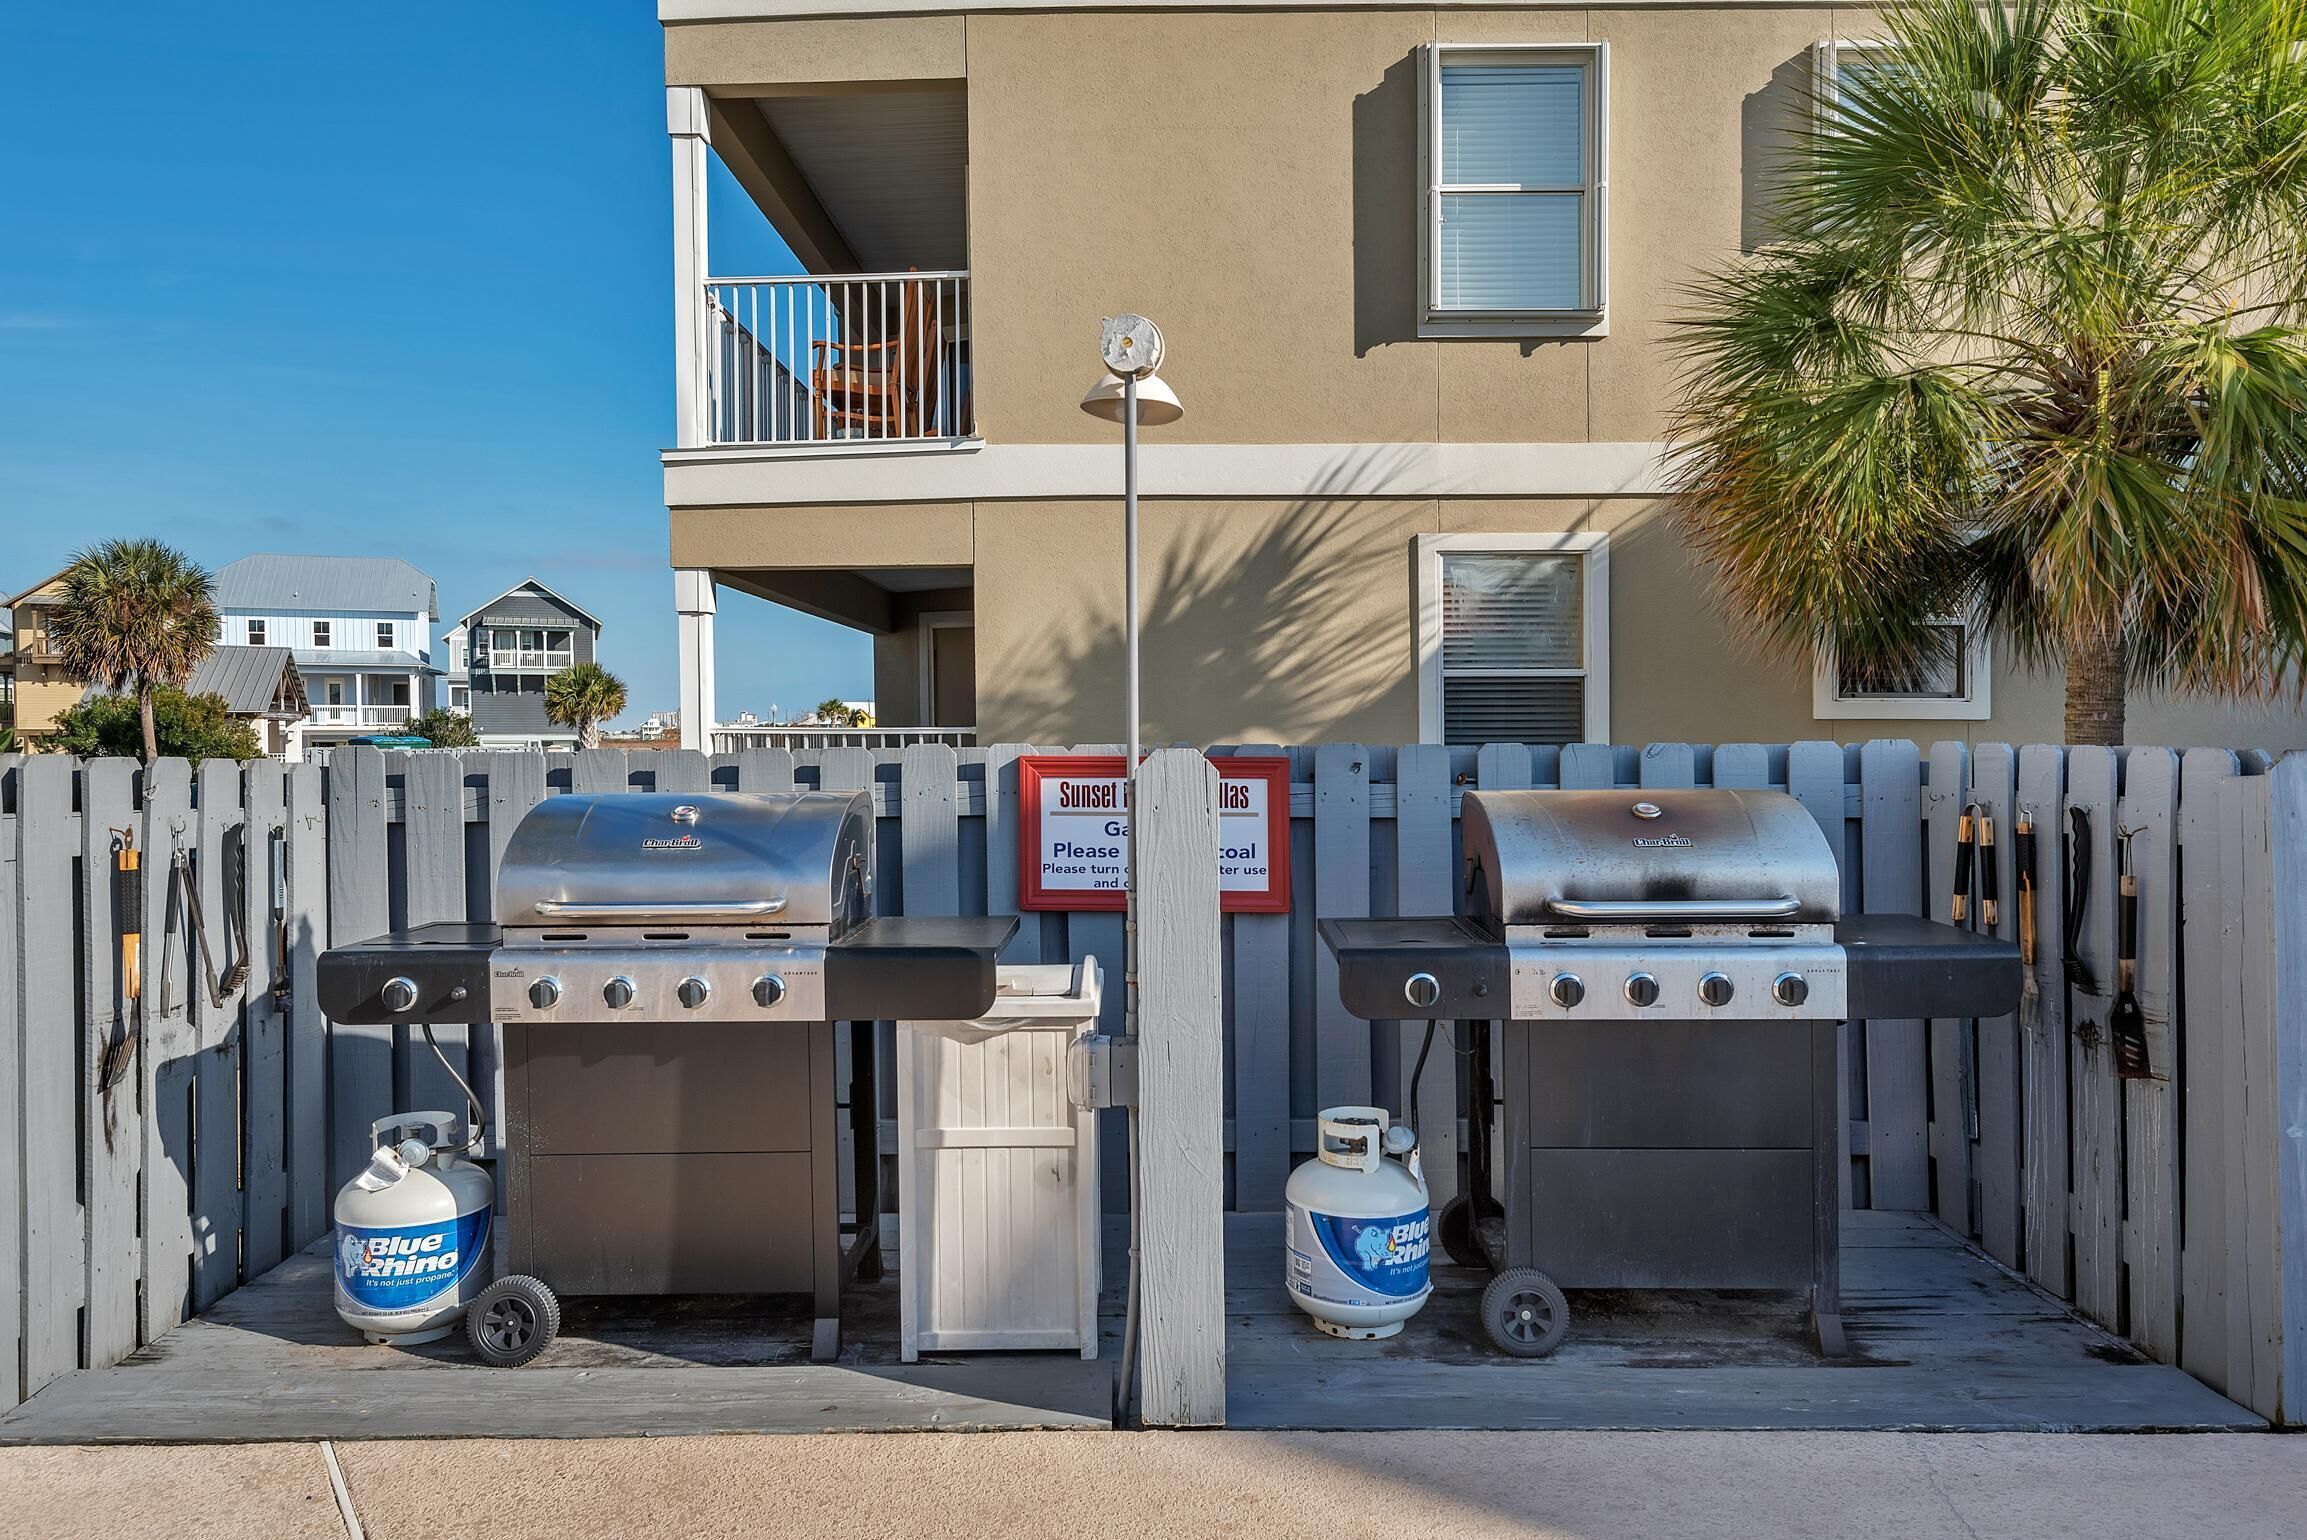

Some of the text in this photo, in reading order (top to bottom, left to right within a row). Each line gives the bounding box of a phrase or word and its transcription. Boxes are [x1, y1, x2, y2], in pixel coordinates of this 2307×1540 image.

[1060, 781, 1118, 809] Sunset
[1219, 782, 1249, 809] llas
[1053, 841, 1120, 858] Please
[1042, 863, 1086, 874] Please
[1090, 864, 1119, 874] turn
[1243, 866, 1267, 875] use
[1093, 877, 1119, 888] and
[1392, 1216, 1430, 1244] Blue
[368, 1233, 444, 1256] Blue
[1384, 1238, 1430, 1266] Rhin
[360, 1249, 459, 1277] Rhino
[366, 1279, 379, 1287] It's
[380, 1279, 395, 1287] not
[396, 1277, 414, 1287] just
